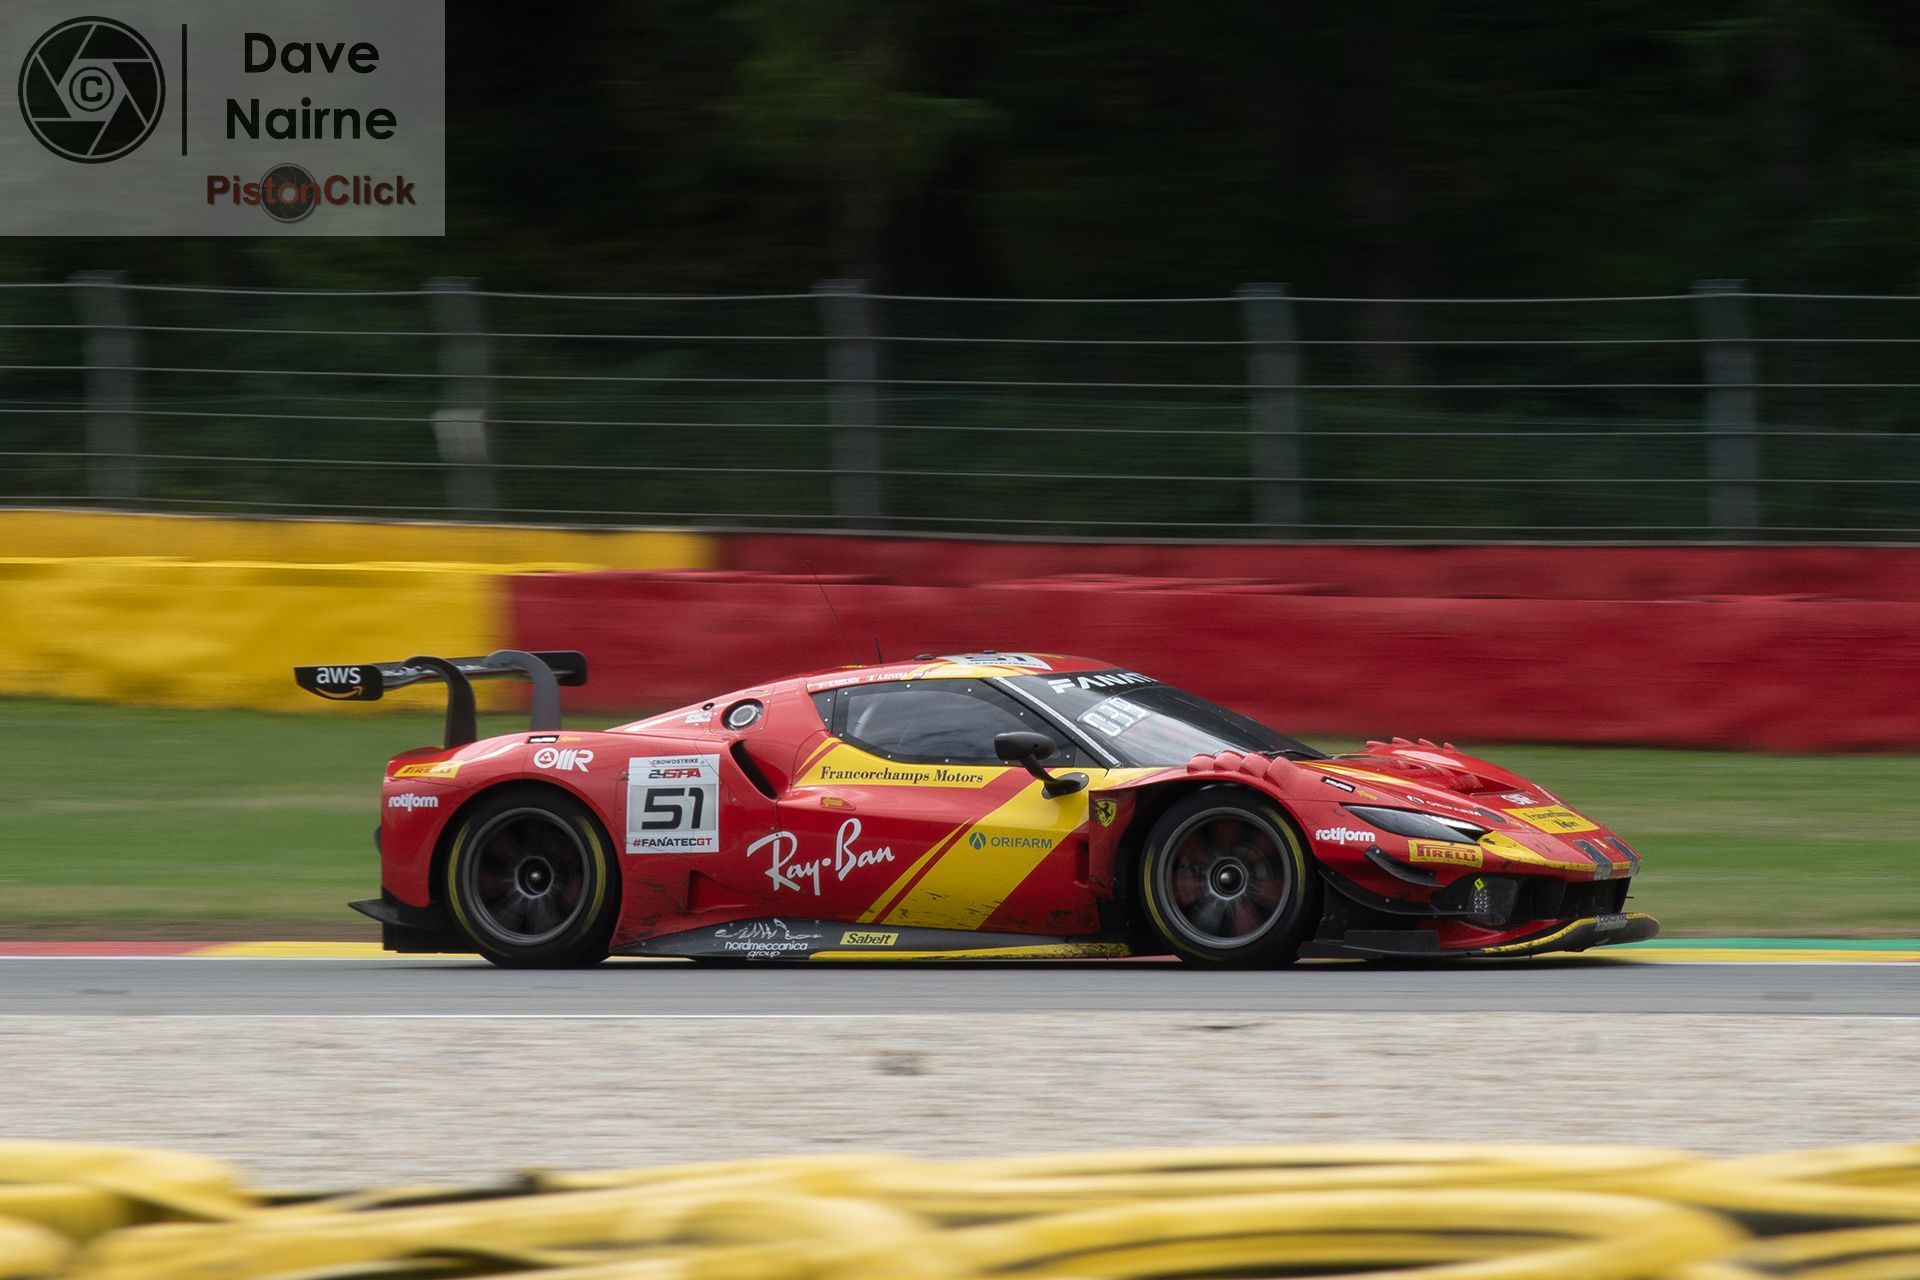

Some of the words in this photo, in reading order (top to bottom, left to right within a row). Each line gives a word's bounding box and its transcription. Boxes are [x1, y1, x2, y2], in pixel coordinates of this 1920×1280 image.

[316, 666, 362, 684] aws
[650, 758, 699, 767] CROWDSTRIKE
[820, 766, 930, 785] Francorchamps
[933, 769, 984, 784] Motors
[388, 793, 439, 812] rotiform
[641, 786, 705, 831] 51
[633, 837, 713, 848] #FANATECGT
[990, 837, 1053, 849] ORIFARM
[1315, 826, 1376, 846] rotiform
[1416, 843, 1479, 863] PIRELLI
[724, 939, 809, 951] nordmeccanica
[847, 932, 891, 945] Sabelt
[746, 951, 781, 959] group
